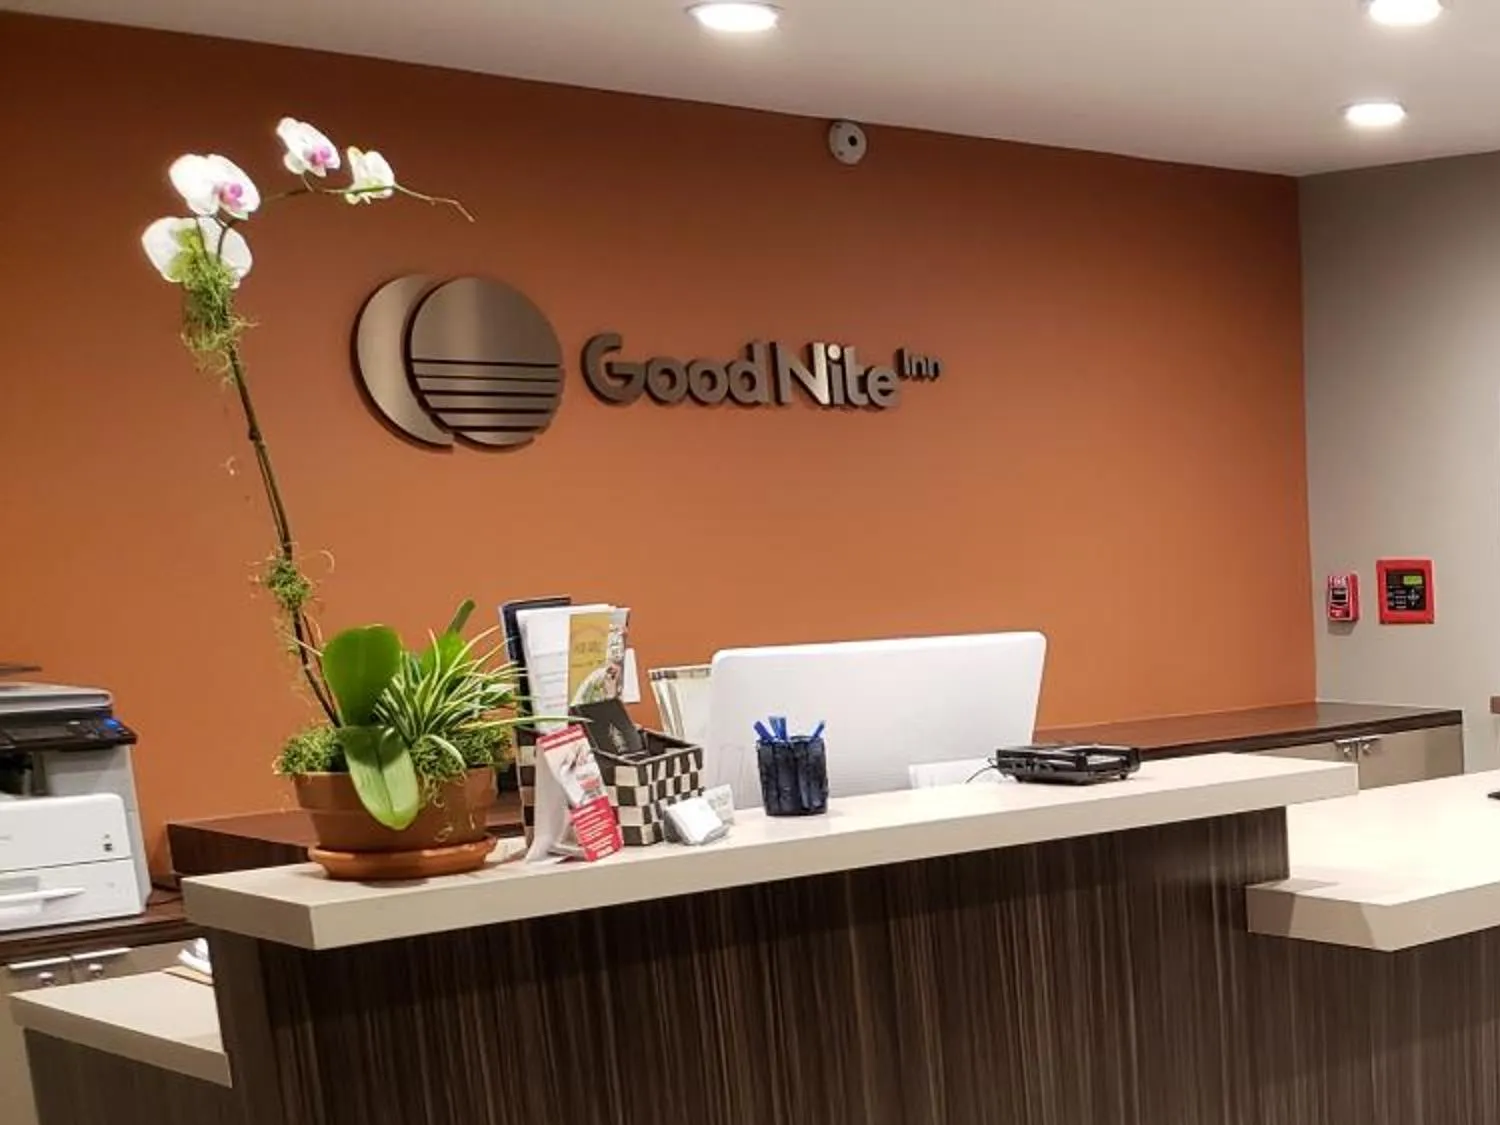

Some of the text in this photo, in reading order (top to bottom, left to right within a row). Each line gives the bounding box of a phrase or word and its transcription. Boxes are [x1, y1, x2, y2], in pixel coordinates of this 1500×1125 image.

[580, 333, 943, 409] Good Nite Inn
